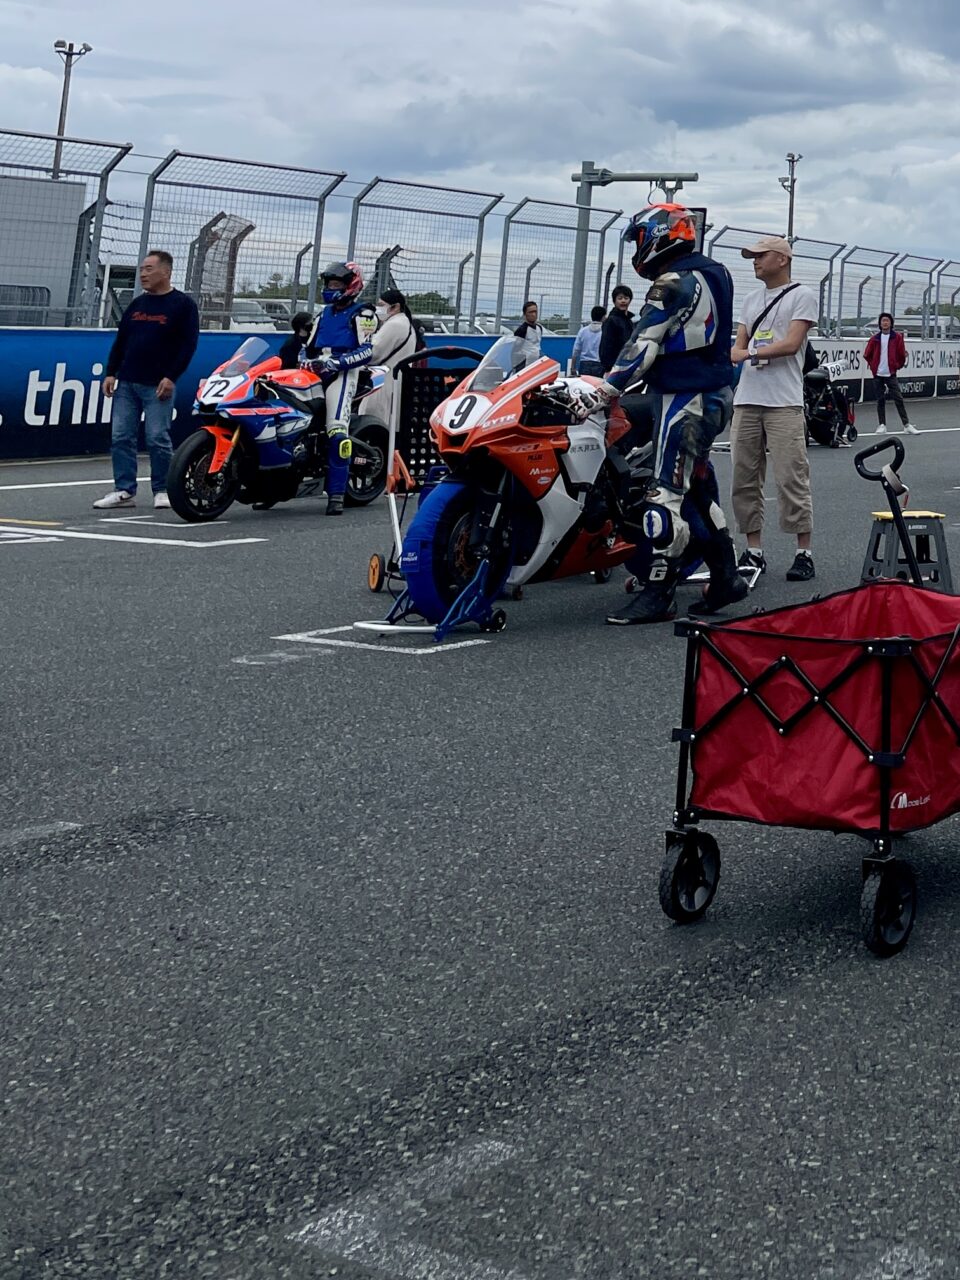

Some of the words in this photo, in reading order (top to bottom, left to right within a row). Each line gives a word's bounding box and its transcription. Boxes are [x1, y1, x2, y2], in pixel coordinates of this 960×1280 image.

[344, 347, 373, 365] YAMAHA
[832, 350, 860, 370] YEARS
[911, 350, 935, 368] YEARS
[830, 365, 841, 377] 98
[203, 380, 230, 398] 72
[449, 395, 477, 429] 9
